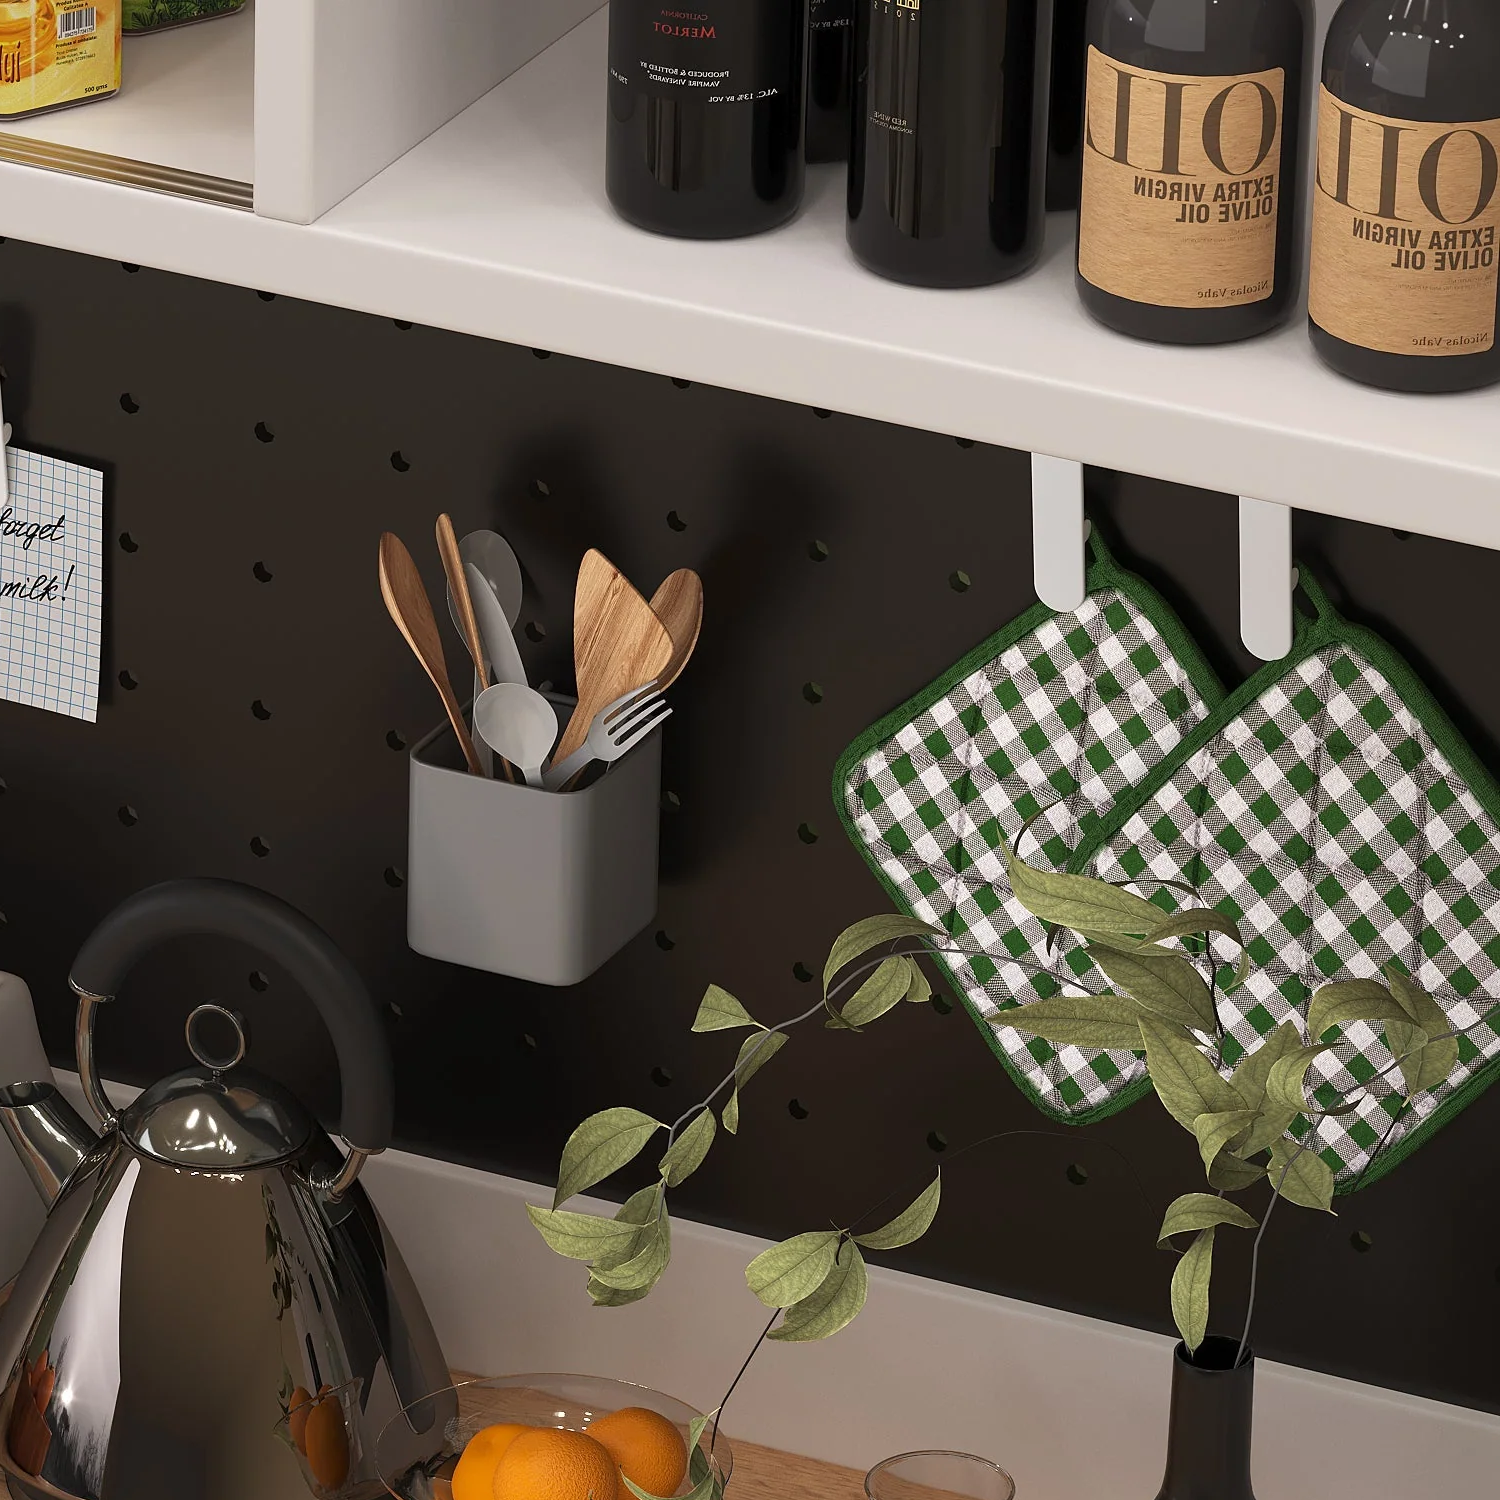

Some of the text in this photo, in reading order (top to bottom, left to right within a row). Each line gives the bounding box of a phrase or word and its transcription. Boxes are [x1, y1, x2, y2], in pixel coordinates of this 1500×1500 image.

[84, 84, 108, 94] 500 gms
[0, 564, 76, 602] milk!
